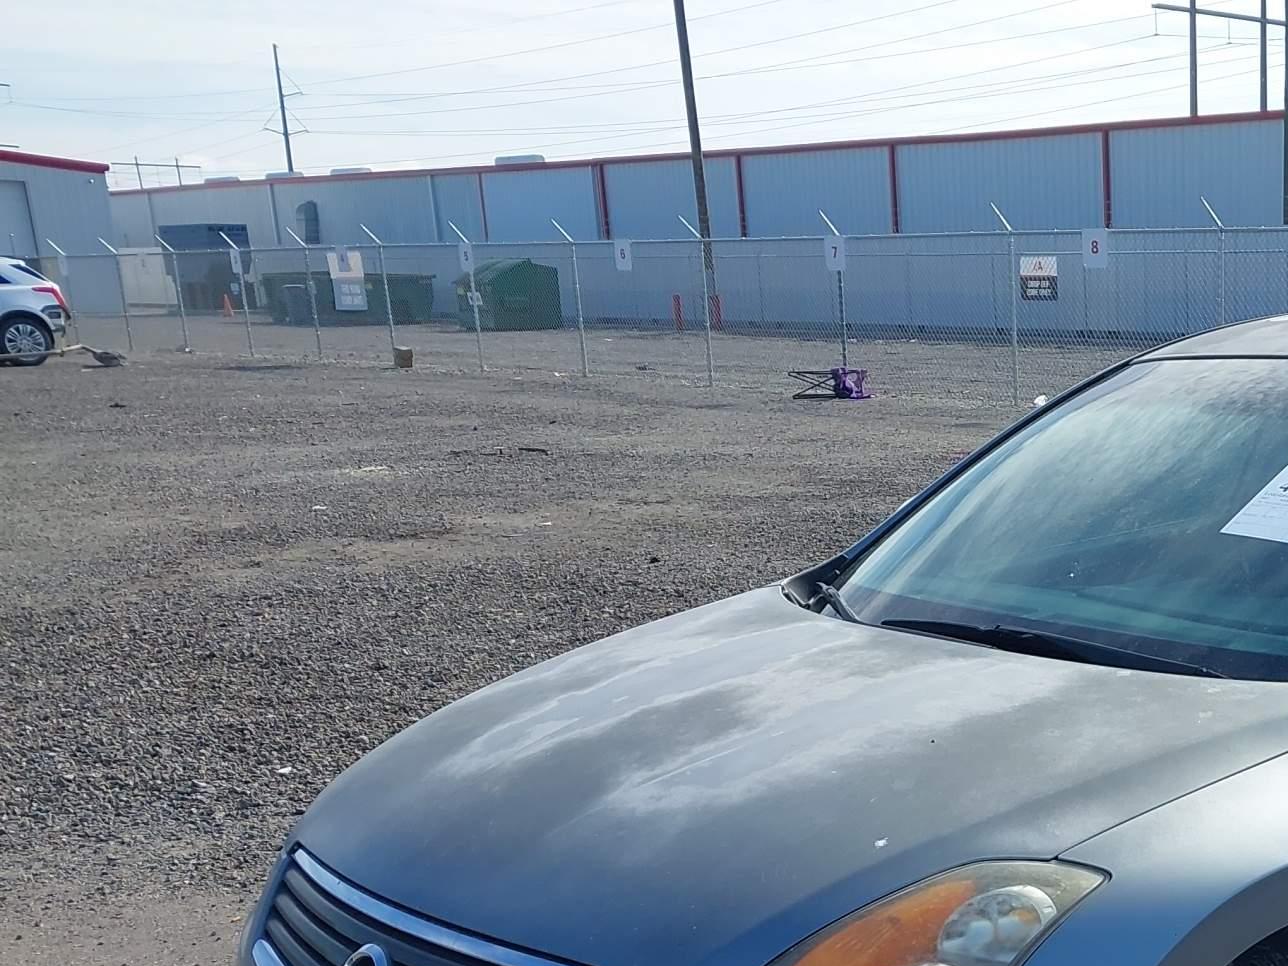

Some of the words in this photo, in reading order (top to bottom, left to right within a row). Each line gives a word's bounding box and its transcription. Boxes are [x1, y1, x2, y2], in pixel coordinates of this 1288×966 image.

[831, 246, 838, 258] 7
[1091, 240, 1099, 254] 8
[620, 248, 626, 260] 6
